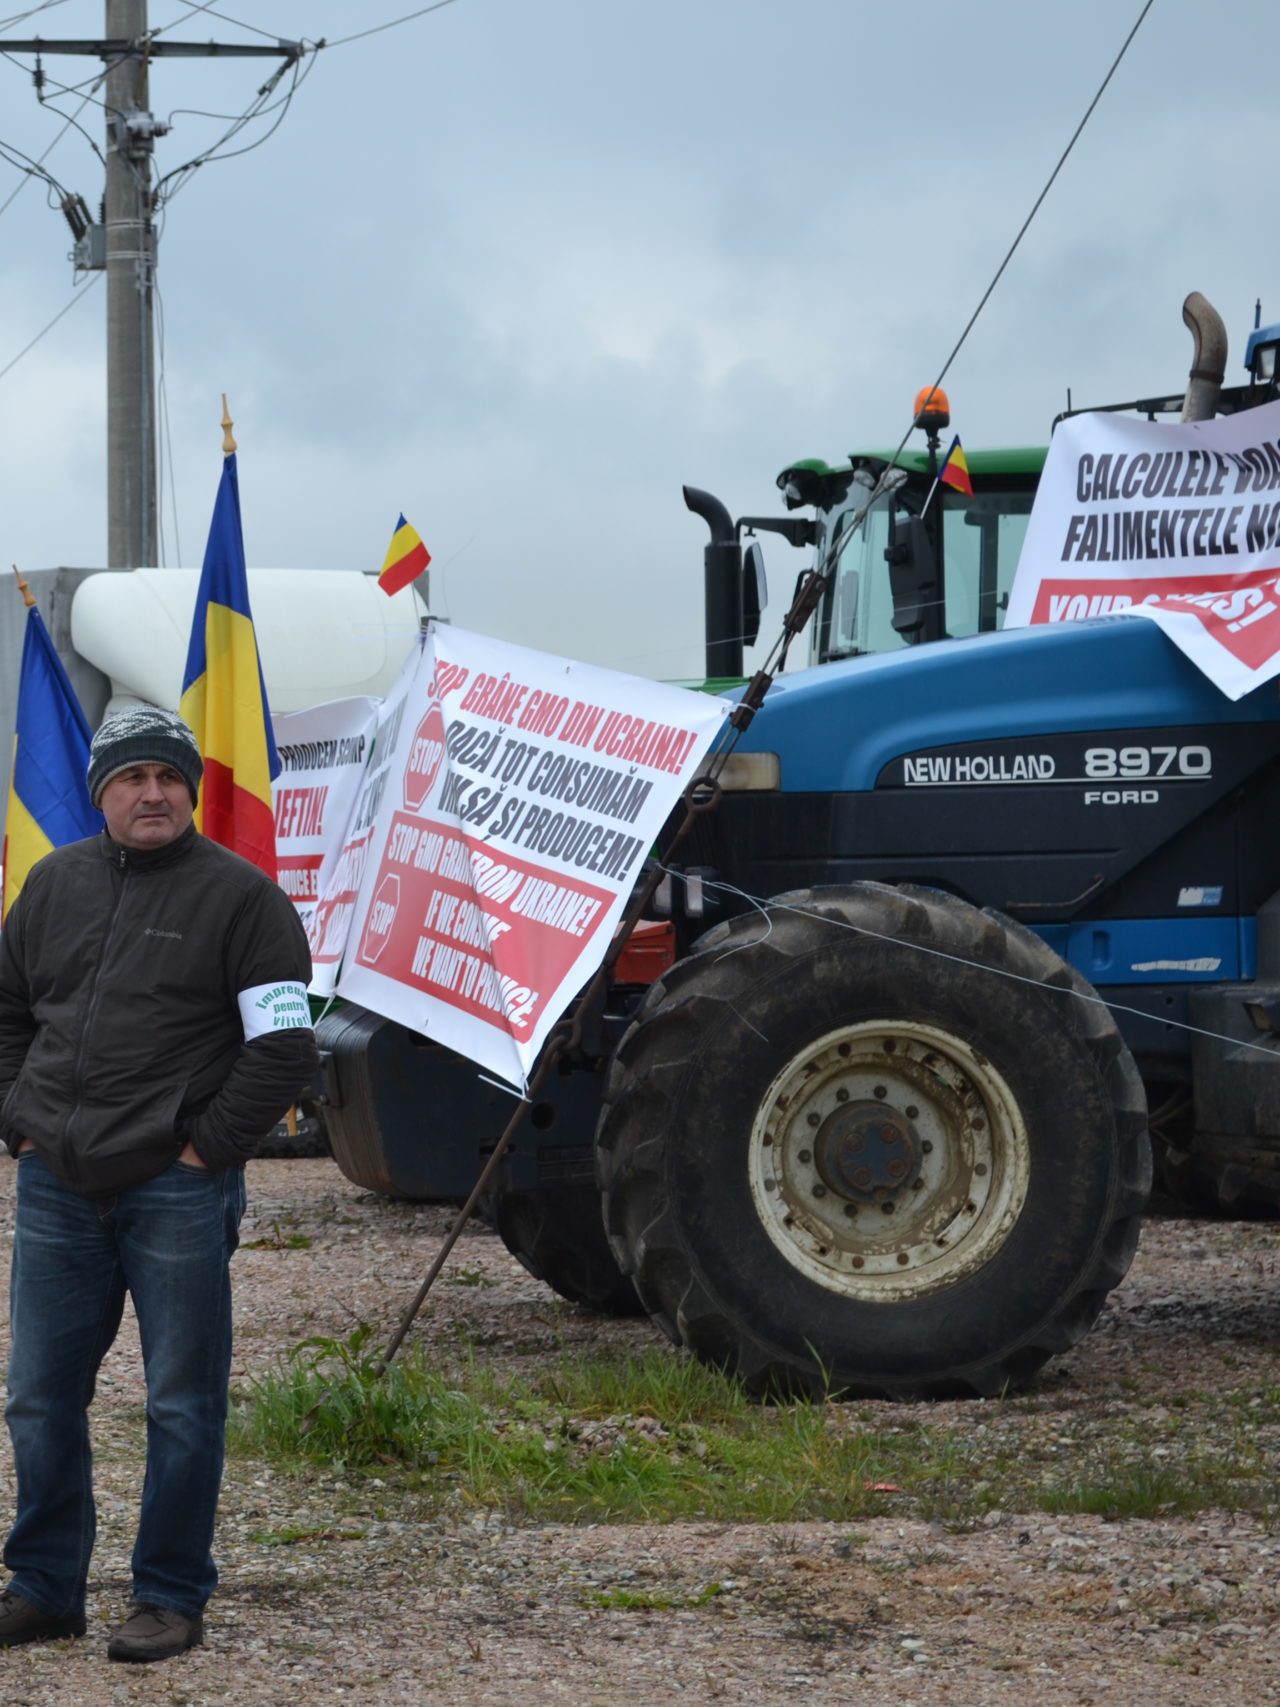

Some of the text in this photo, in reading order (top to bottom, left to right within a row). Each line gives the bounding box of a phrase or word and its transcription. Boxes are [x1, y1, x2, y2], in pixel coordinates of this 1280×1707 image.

[1076, 438, 1280, 503] CALCULELE VOA
[1061, 505, 1245, 562] FALIMENTELE
[459, 672, 530, 726] GRÂNE
[516, 689, 570, 738] GMO
[557, 700, 606, 749] DIN
[592, 710, 699, 776] UCRAINA!
[410, 737, 442, 776] STOP
[490, 738, 541, 787] TOT
[526, 750, 655, 825] CONSUMĂM
[903, 745, 1212, 782] NEW HOLLAND 8970
[1084, 790, 1160, 805] FORD
[511, 803, 645, 882] PRODUCEM!
[387, 822, 420, 865] STOP
[413, 830, 445, 874] GMO
[509, 876, 603, 937] UKRAINE!
[370, 900, 396, 936] STOP
[423, 889, 443, 929] IF
[434, 893, 461, 936] WE
[410, 935, 437, 979] WE
[427, 942, 468, 992] WANT
[458, 954, 481, 999] TO
[273, 1000, 305, 1014] pentru
